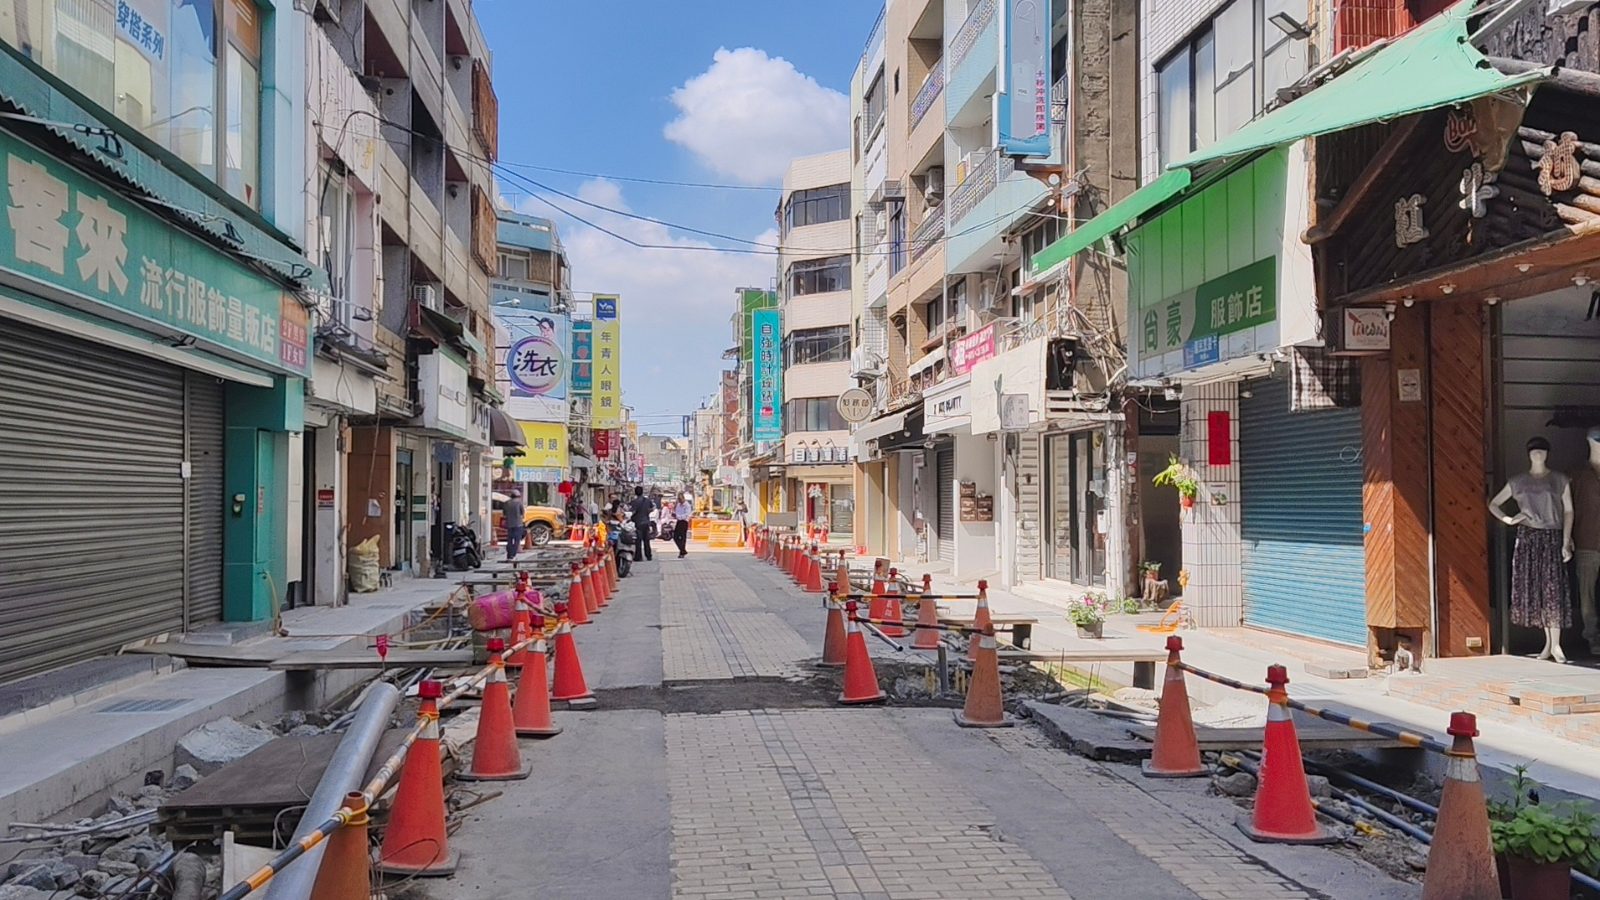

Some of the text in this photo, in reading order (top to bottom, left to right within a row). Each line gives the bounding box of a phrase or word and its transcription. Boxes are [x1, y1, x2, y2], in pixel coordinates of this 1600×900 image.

[116, 1, 165, 61] 穿搭系列
[140, 255, 276, 356] 流行服飾量販店
[1143, 285, 1263, 353] 尚豪 服飾店
[512, 350, 559, 377] 洗衣
[600, 331, 613, 408] 年青人眼鏡
[534, 437, 558, 451] 眼鏡
